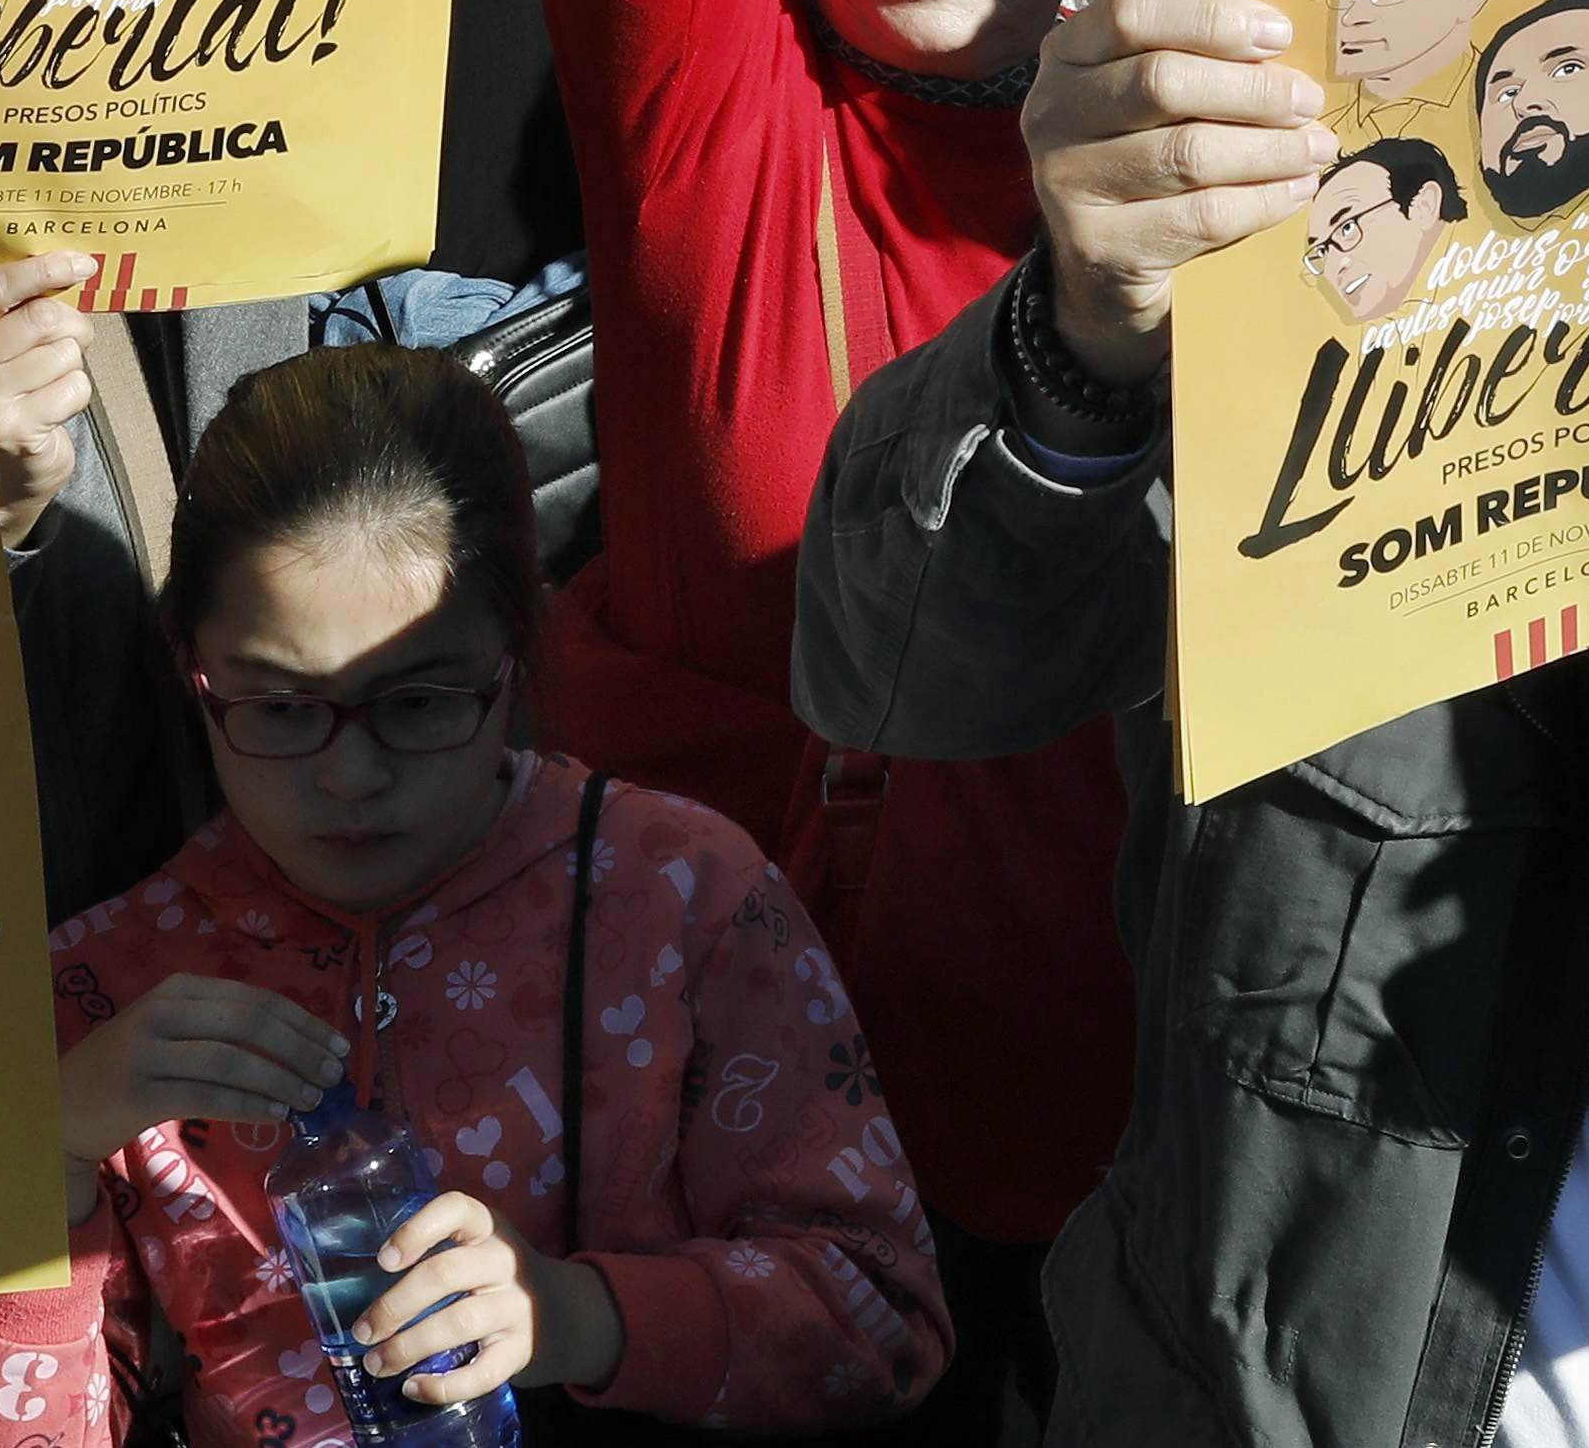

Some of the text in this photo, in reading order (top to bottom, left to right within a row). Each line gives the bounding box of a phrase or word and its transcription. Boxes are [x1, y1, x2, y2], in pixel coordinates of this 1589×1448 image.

[4, 89, 207, 126] PRESOS POLÍTICS
[27, 121, 288, 174] REPÚBLICA
[6, 216, 167, 238] BARCELONA
[1427, 228, 1560, 290] dolors
[1442, 431, 1545, 486] PRESOS
[1336, 509, 1466, 590] SOM
[1389, 560, 1480, 610] DISSABTE
[1487, 548, 1511, 571] 11
[1515, 536, 1544, 558] DE
